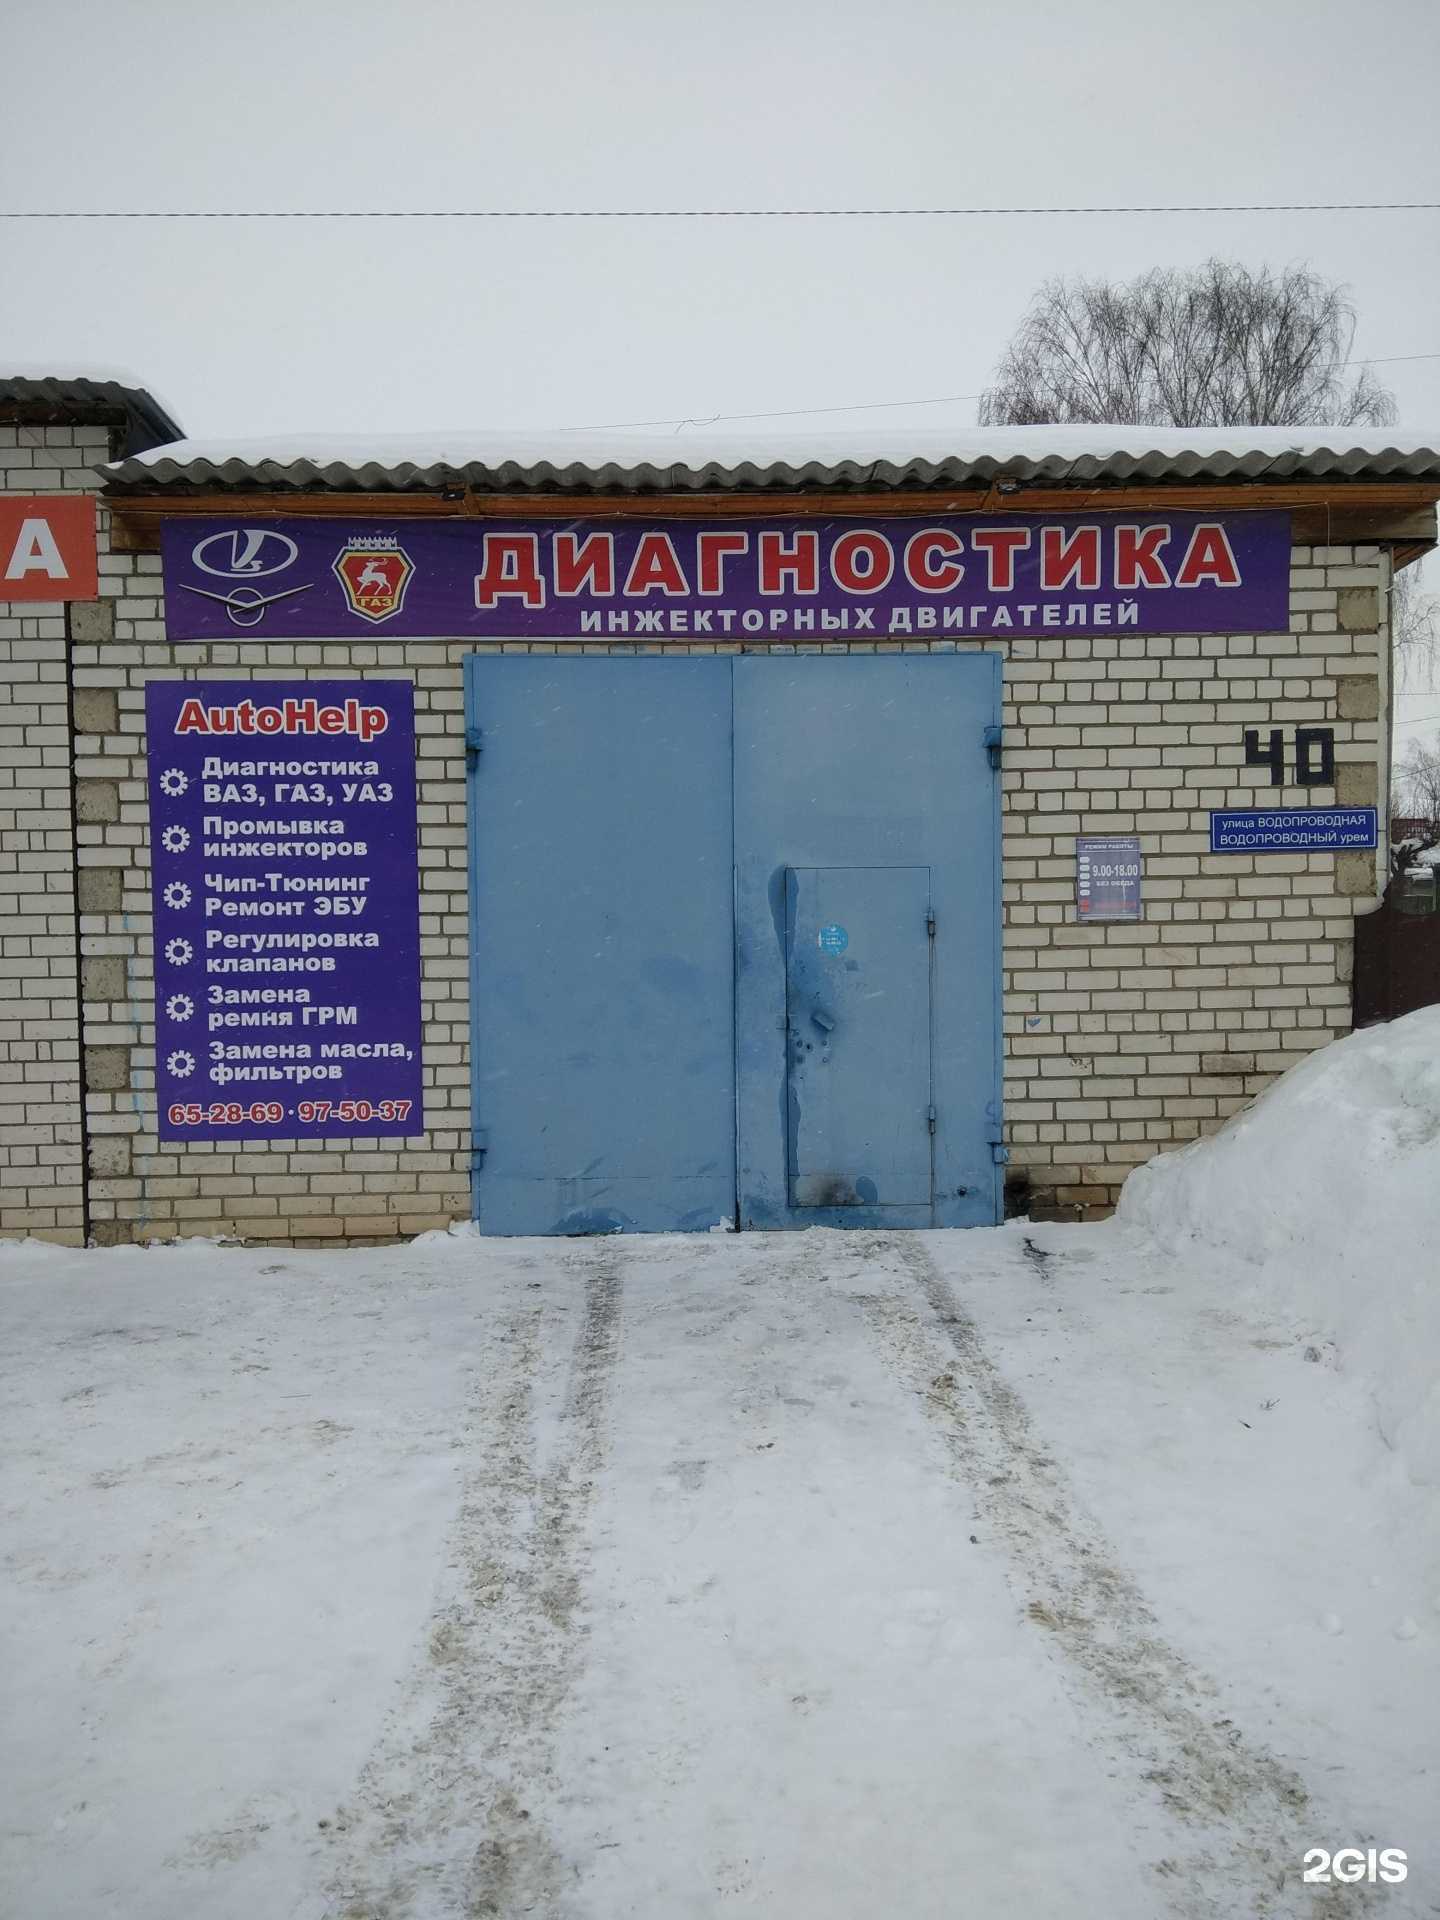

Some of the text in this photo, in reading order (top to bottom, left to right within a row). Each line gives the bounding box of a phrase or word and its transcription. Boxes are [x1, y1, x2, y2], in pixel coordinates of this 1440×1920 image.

[474, 523, 1243, 609] ДИАГНОСТИКА
[360, 598, 393, 607] ГАЗ
[579, 599, 1140, 634] ИНЖЕКТОРНЫХ ДВИГАТЕЛЕЙ
[175, 698, 388, 742] AutoHelp
[201, 756, 380, 780] Диагностика
[1245, 728, 1334, 785] 40
[203, 783, 394, 807] ВАЗ, ГАЗ, УАЗ
[203, 816, 345, 839] Промывка
[1222, 815, 1366, 829] улица ВОДОПРОВОДНАЯ
[1220, 831, 1337, 846] ВОДОПРОВОДНЫЙ
[203, 842, 368, 861] инжекторов
[1092, 864, 1138, 877] 9.00-18.00
[204, 873, 371, 893] Чип-Тюнинг
[205, 896, 367, 917] Ремонт ЭБУ
[206, 930, 380, 953] Регулировка
[206, 956, 336, 973] клапанов
[207, 985, 311, 1004] Замена
[208, 1006, 357, 1031] ремня ГРМ
[209, 1041, 414, 1061] Замена масла,
[209, 1063, 343, 1086] фильтров
[168, 1099, 412, 1125] 65-28-69 97-50-37
